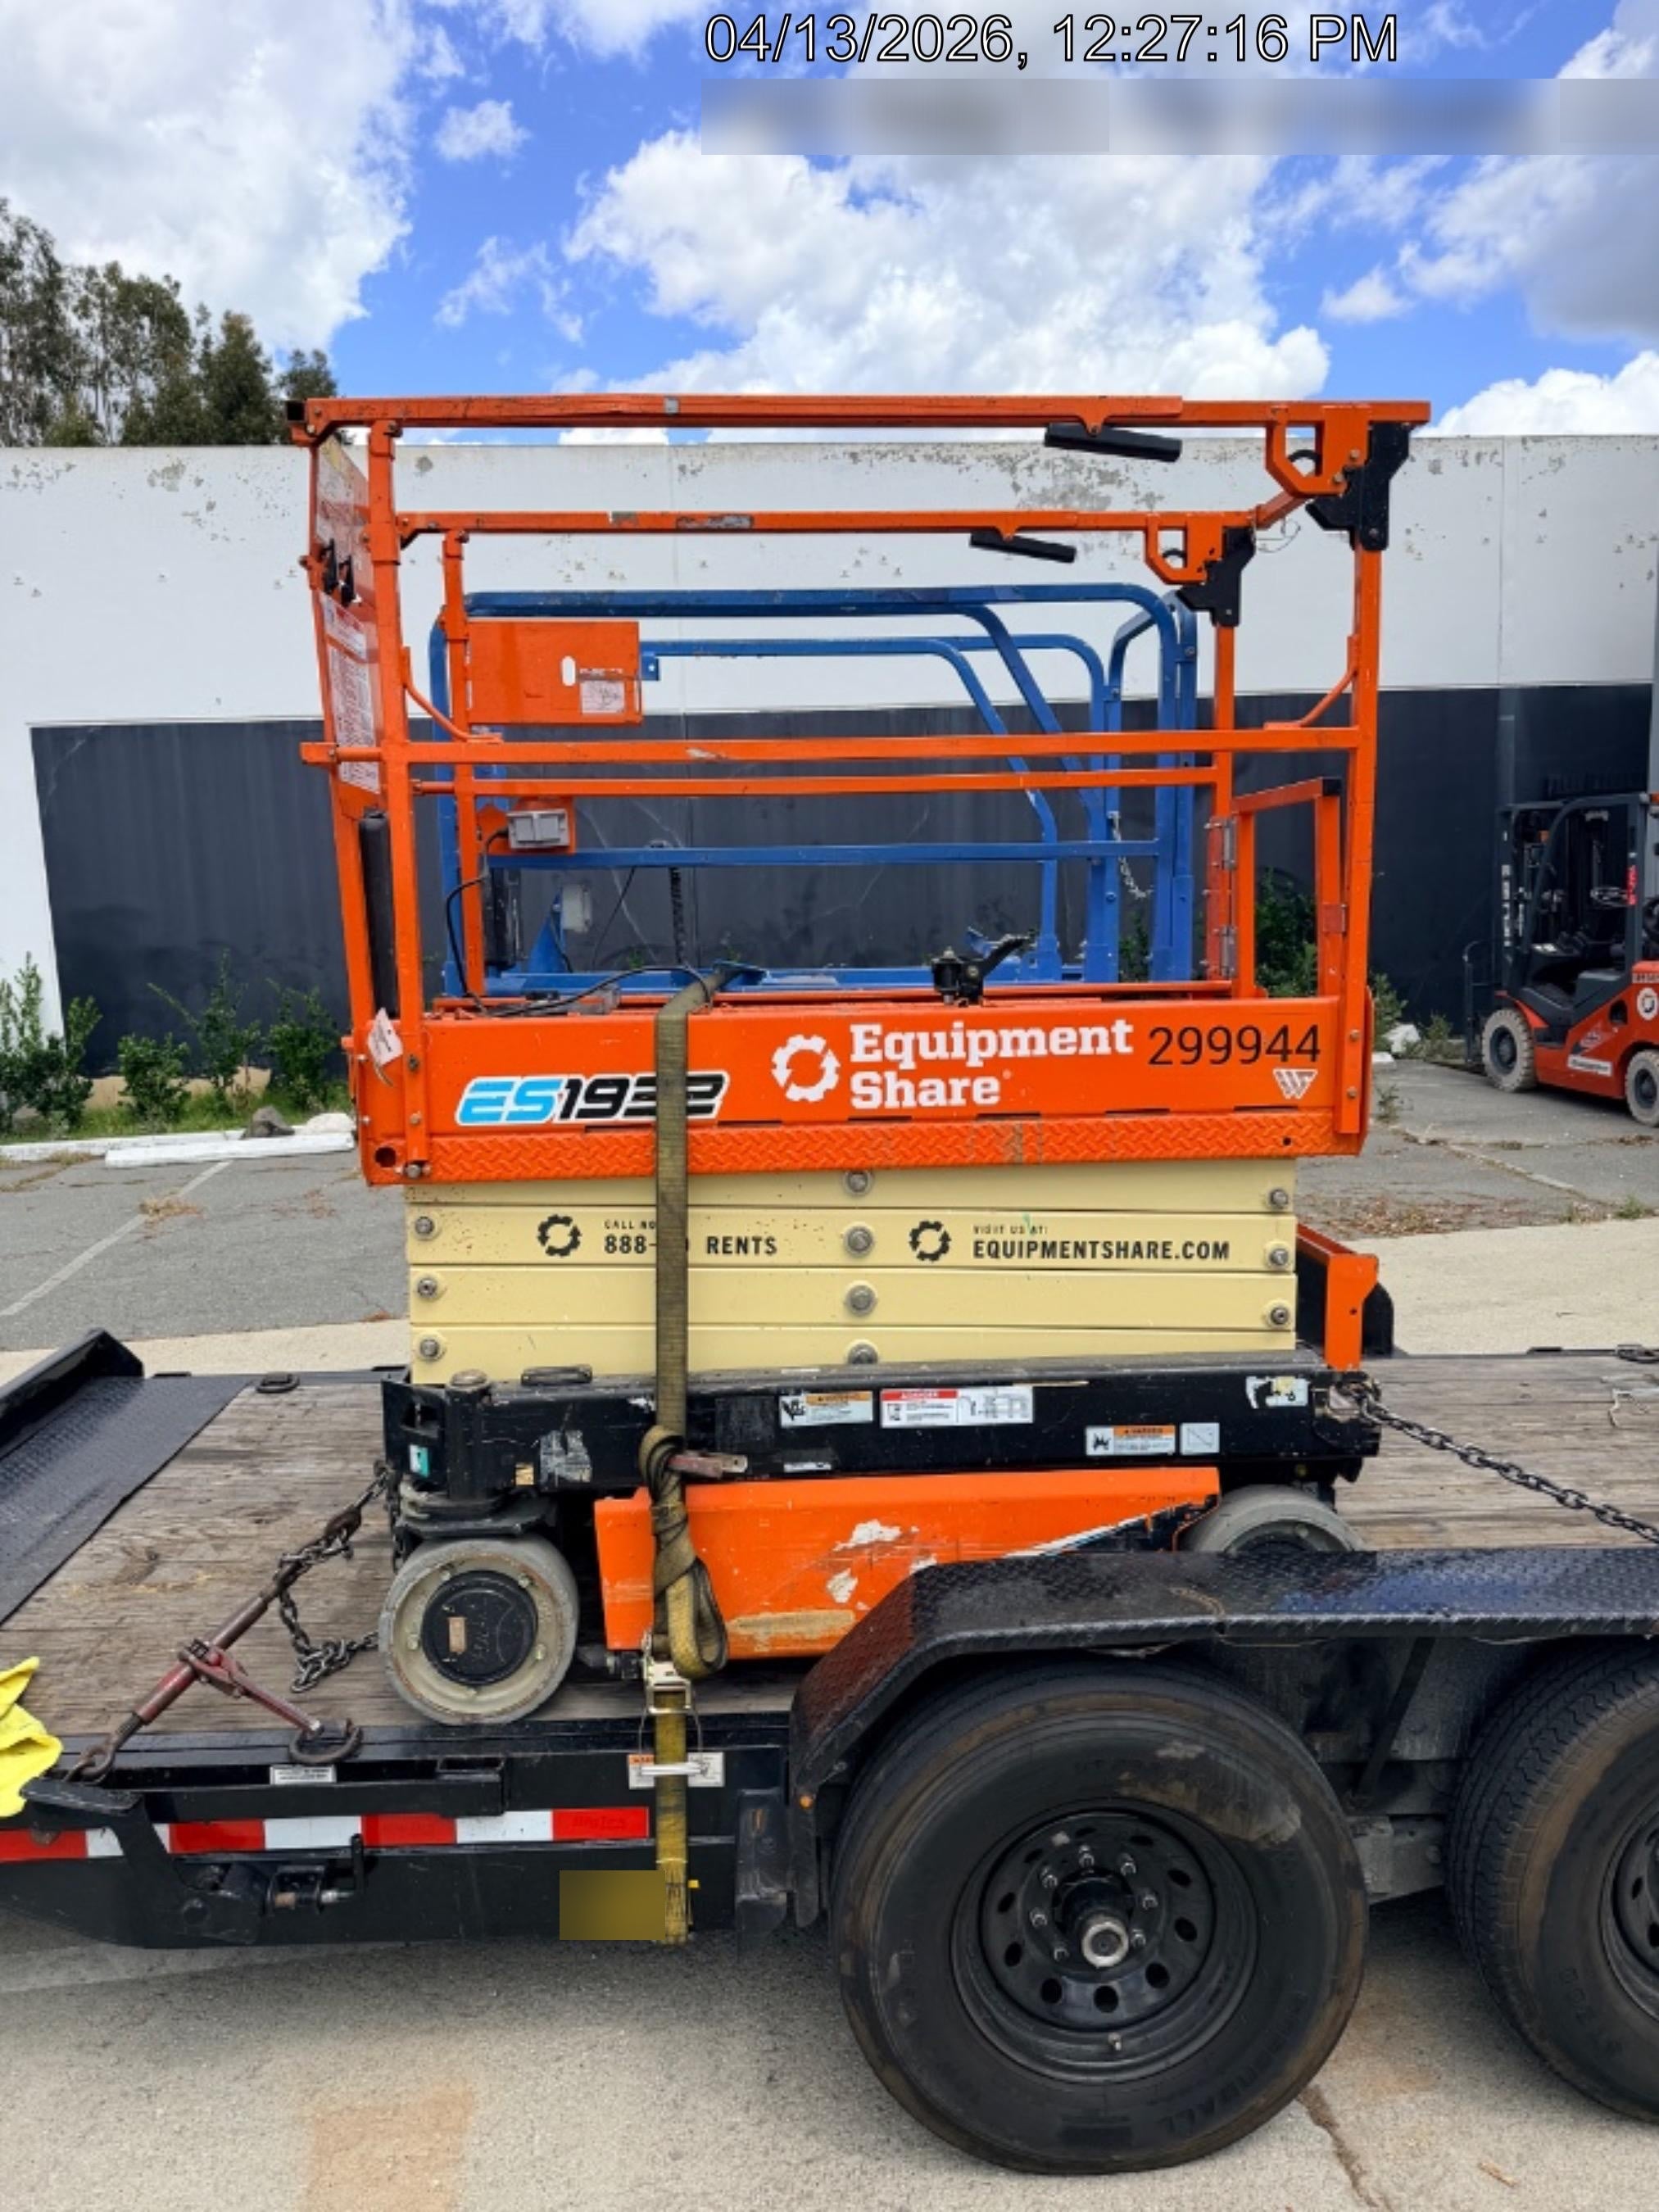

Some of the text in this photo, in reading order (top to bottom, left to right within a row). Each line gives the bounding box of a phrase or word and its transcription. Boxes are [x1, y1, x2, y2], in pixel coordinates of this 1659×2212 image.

[850, 1019, 1134, 1070] Equipment
[1149, 1024, 1321, 1065] 299944
[850, 1070, 1001, 1109] Share
[604, 1219, 635, 1230] CALL
[706, 1235, 778, 1255] RENTS
[972, 1240, 1231, 1260] EQUIPMENTSHARE.COM
